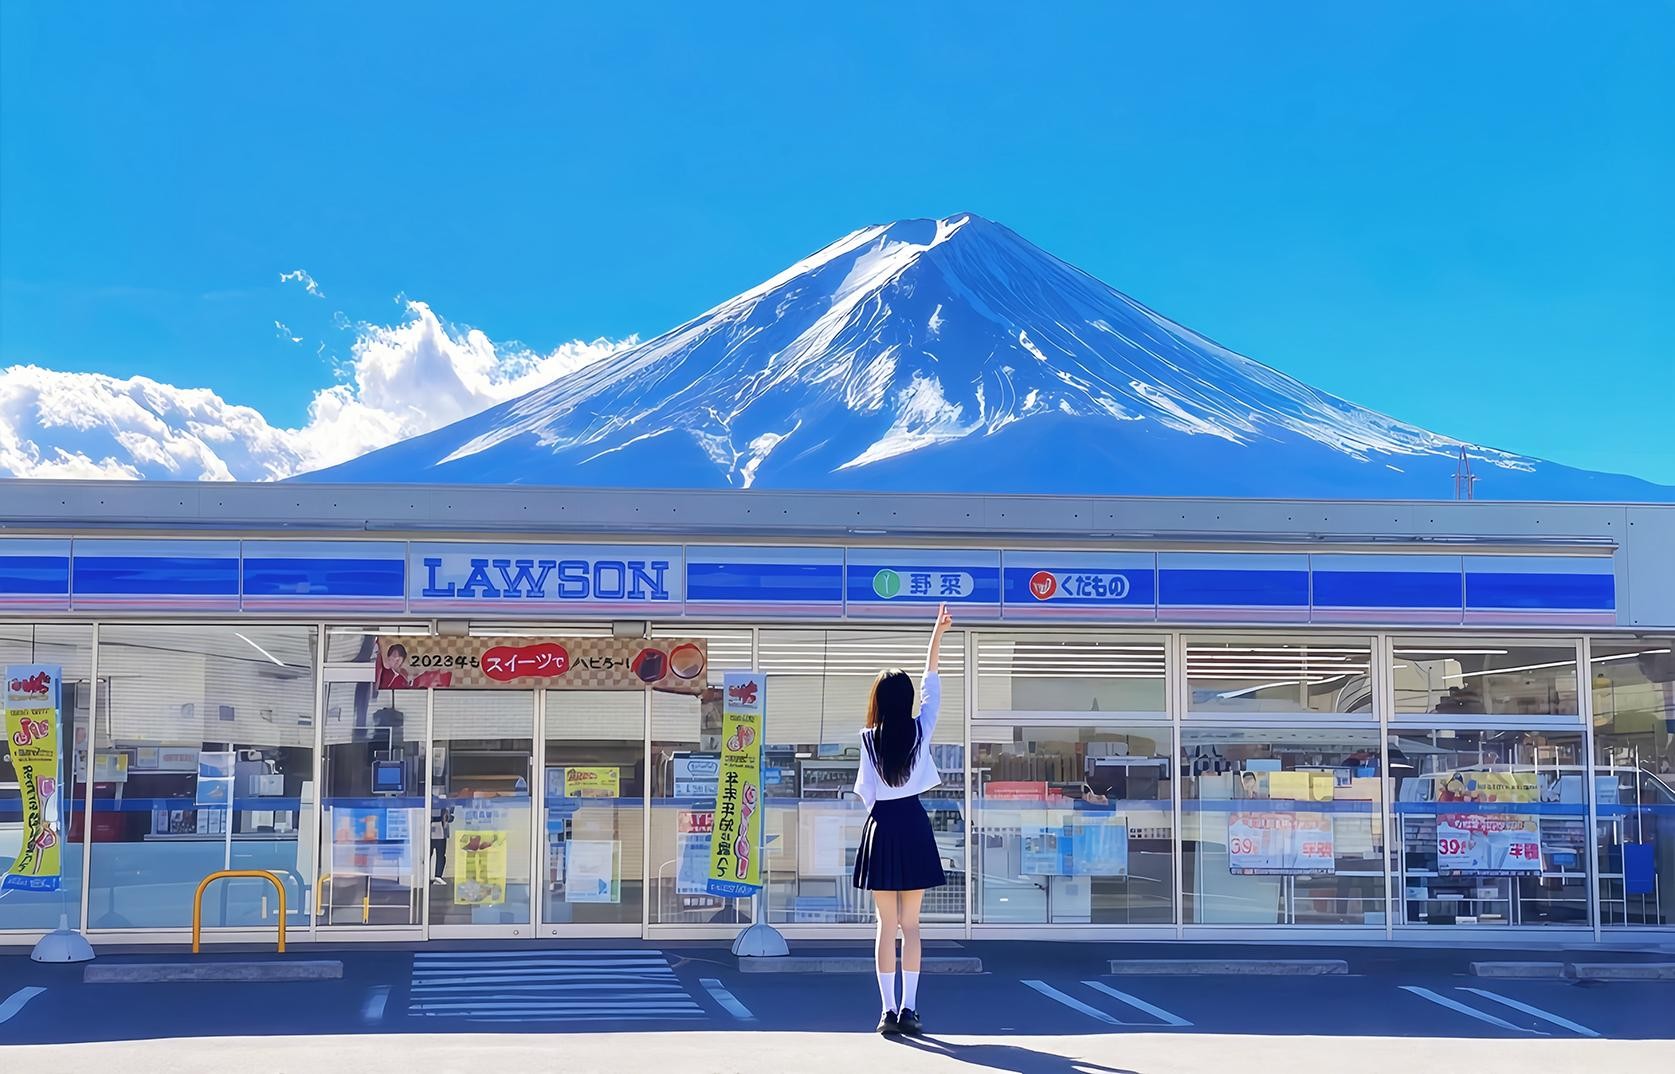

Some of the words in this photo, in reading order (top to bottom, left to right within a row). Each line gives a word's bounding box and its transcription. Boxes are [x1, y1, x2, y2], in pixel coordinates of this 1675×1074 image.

[422, 558, 669, 600] LAWSON
[1061, 575, 1126, 597] くだもの
[487, 653, 565, 673] スイーツで
